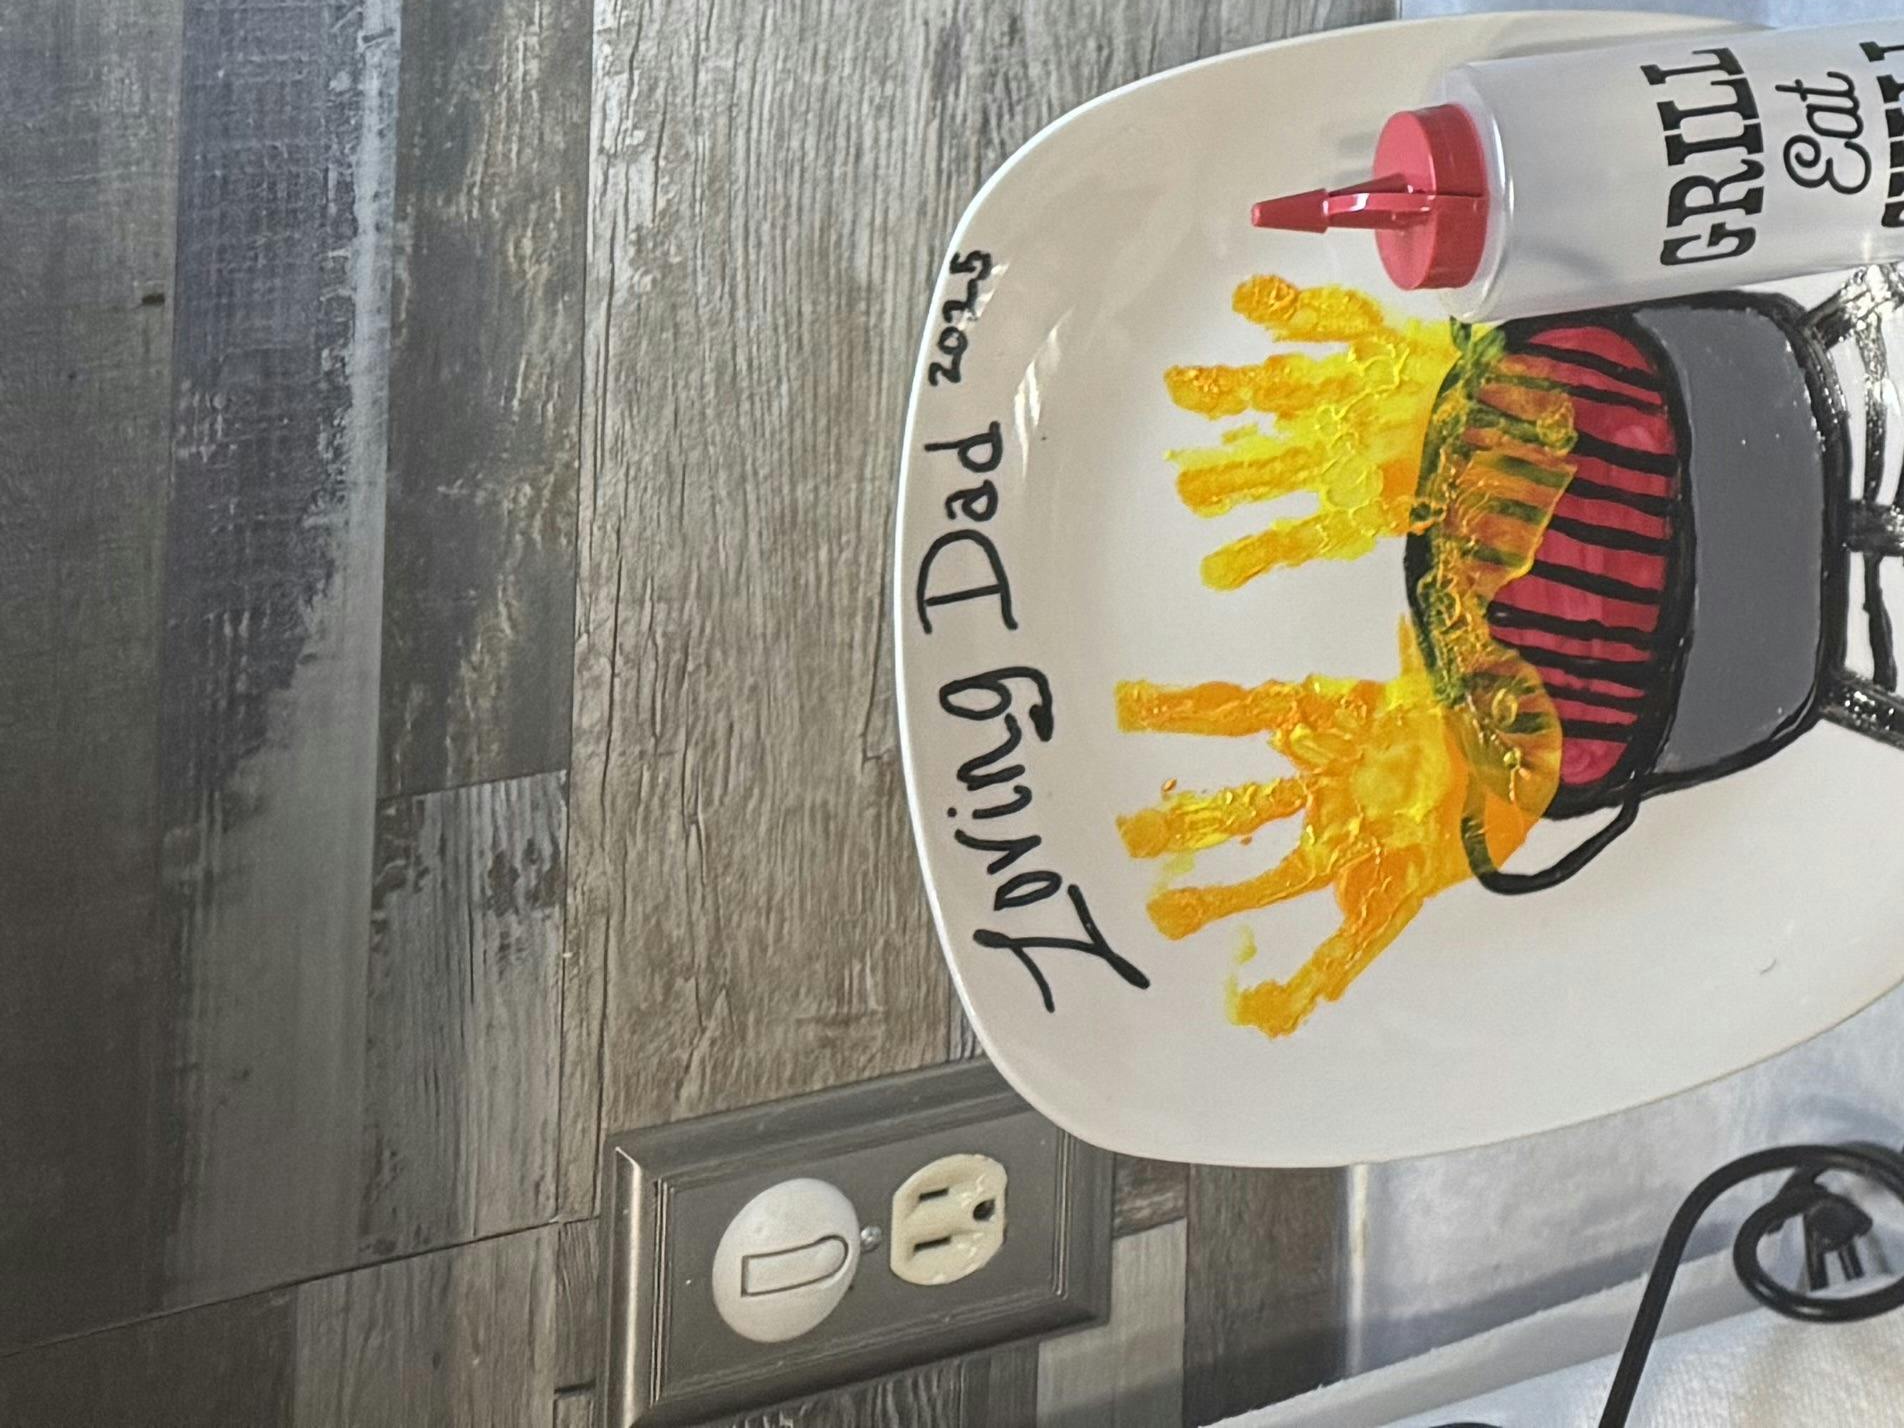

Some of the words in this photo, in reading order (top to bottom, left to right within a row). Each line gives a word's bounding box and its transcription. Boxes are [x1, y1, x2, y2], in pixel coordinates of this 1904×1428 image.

[1641, 47, 1765, 266] GRILL
[1775, 71, 1872, 194] Eat
[929, 251, 993, 386] 2025
[917, 421, 1018, 634] Dad
[938, 665, 1150, 1013] Loving
